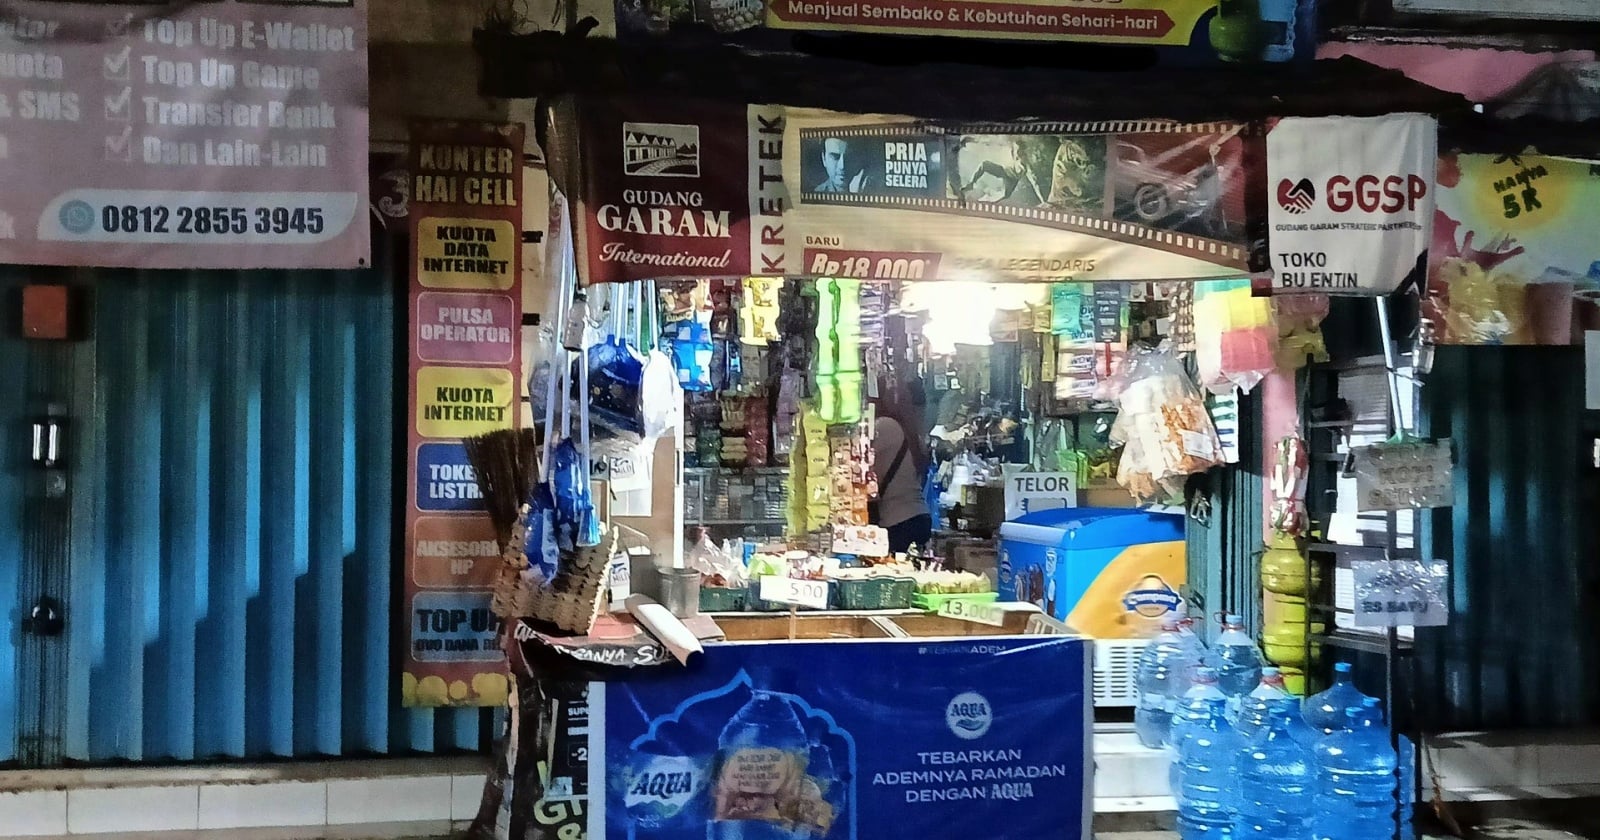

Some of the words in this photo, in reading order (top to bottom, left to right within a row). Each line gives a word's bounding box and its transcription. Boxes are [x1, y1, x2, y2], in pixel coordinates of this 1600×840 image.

[789, 1, 858, 20] Menjual
[862, 4, 943, 21] Sembako
[948, 8, 960, 21] &
[964, 8, 1058, 27] Kebutuhan
[1062, 13, 1158, 30] Sehari-hari
[144, 18, 193, 48] Top
[200, 19, 235, 49] Up
[242, 22, 354, 51] E-Wallet
[142, 56, 194, 88] Top
[200, 59, 235, 89] Up
[242, 61, 320, 90] Game
[18, 90, 80, 122] SMS
[143, 97, 262, 128] Transfer
[268, 101, 336, 129] Bank
[143, 136, 198, 165] Dan
[204, 140, 327, 167] Lain-Lain
[420, 144, 513, 174] KONTER
[885, 142, 927, 161] PRIA
[886, 160, 927, 175] PUNYA
[415, 175, 457, 203] HAI
[463, 177, 517, 206] CELL
[885, 174, 928, 189] SELERA
[623, 188, 704, 207] GUDANG
[757, 113, 785, 275] KRETEK
[1326, 173, 1427, 213] GGSP
[102, 205, 169, 234] 0812
[177, 206, 248, 235] 2855
[254, 207, 324, 235] 3945
[597, 204, 733, 238] GARAM
[1275, 223, 1308, 231] GUDANG
[1310, 223, 1339, 231] GARAM
[436, 225, 497, 243] KUOTA
[806, 235, 840, 246] BARU
[444, 242, 490, 258] DATA
[599, 242, 732, 269] International
[423, 258, 509, 275] INTERNET
[1001, 257, 1096, 272] LEGENDARIS
[1278, 251, 1327, 268] TOKO
[1281, 272, 1305, 288] BU
[1310, 272, 1358, 288] ENTIN
[438, 307, 494, 325] PULSA
[420, 324, 511, 343] OPERATOR
[436, 386, 494, 404] KUOTA
[424, 405, 506, 422] INTERNET
[429, 463, 477, 481] TOKE
[429, 482, 484, 499] LISTR
[1014, 477, 1070, 492] TELOR
[416, 540, 501, 558] AKSESORI
[451, 559, 475, 575] HP
[416, 608, 467, 634] TOP
[950, 703, 987, 718] AQUA
[917, 749, 1022, 765] TEBARKAN
[872, 769, 968, 785] ADEMNYA
[971, 764, 1066, 781] RAMADAN
[630, 771, 692, 801] AQUA
[905, 787, 986, 803] DENGAN
[990, 783, 1034, 801] AQUA
